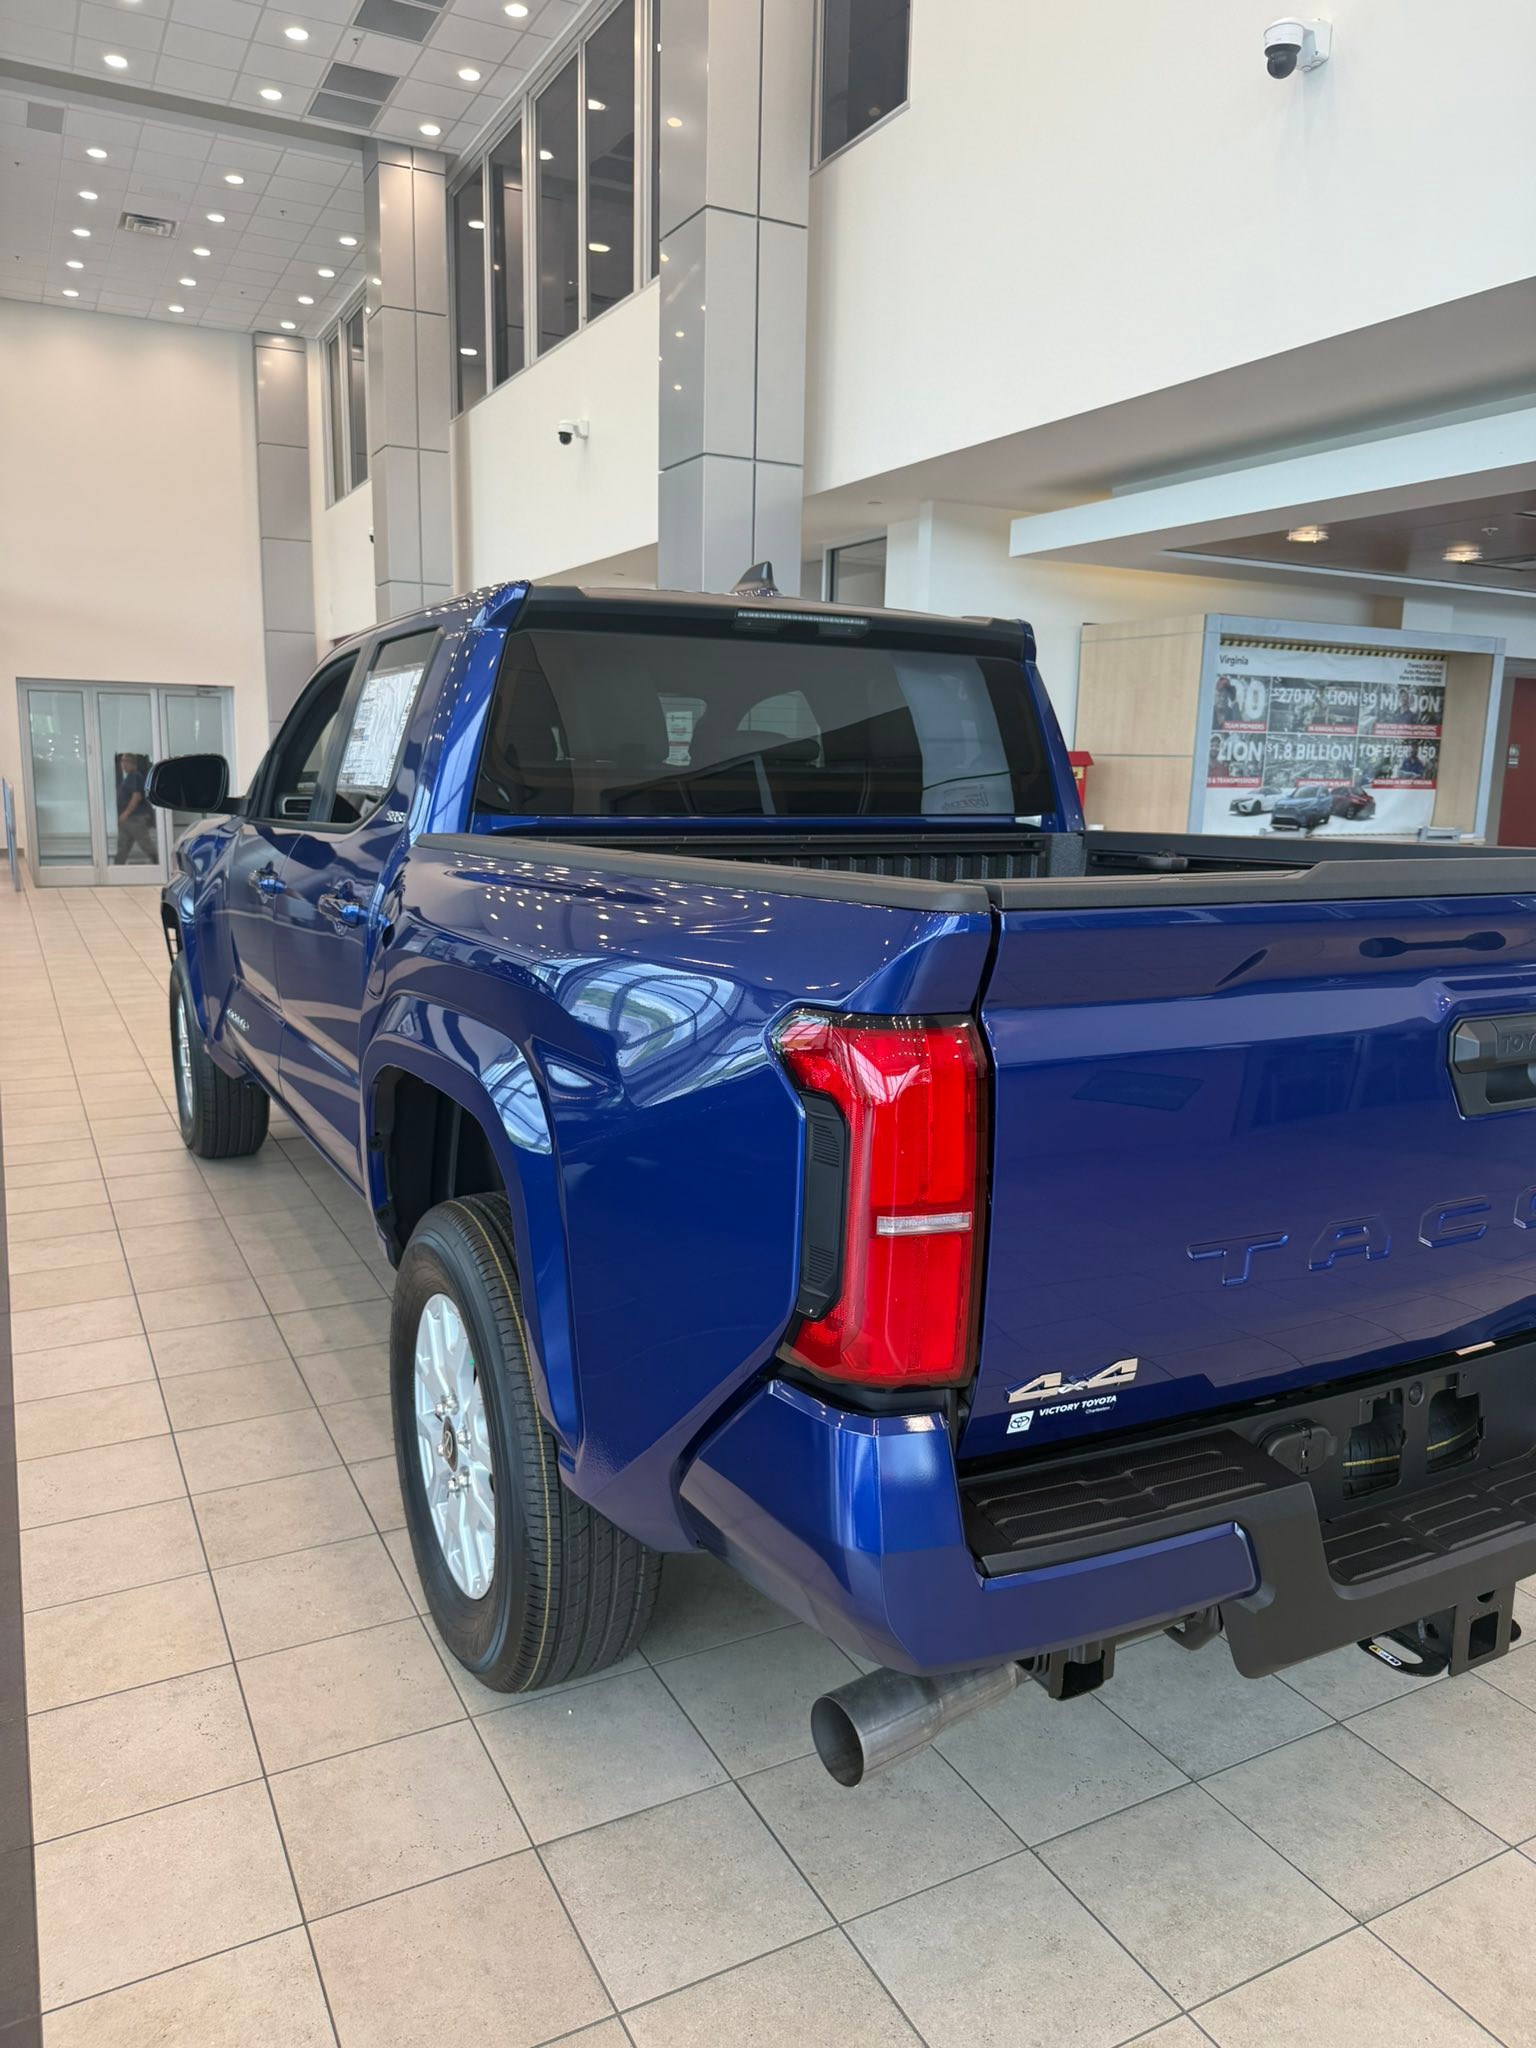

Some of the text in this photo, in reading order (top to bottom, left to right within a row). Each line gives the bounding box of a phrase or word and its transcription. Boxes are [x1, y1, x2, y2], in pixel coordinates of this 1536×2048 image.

[1219, 654, 1249, 667] Virginia
[1295, 743, 1354, 761] BILLION
[1039, 1395, 1117, 1417] VICTORY TOYOTA
